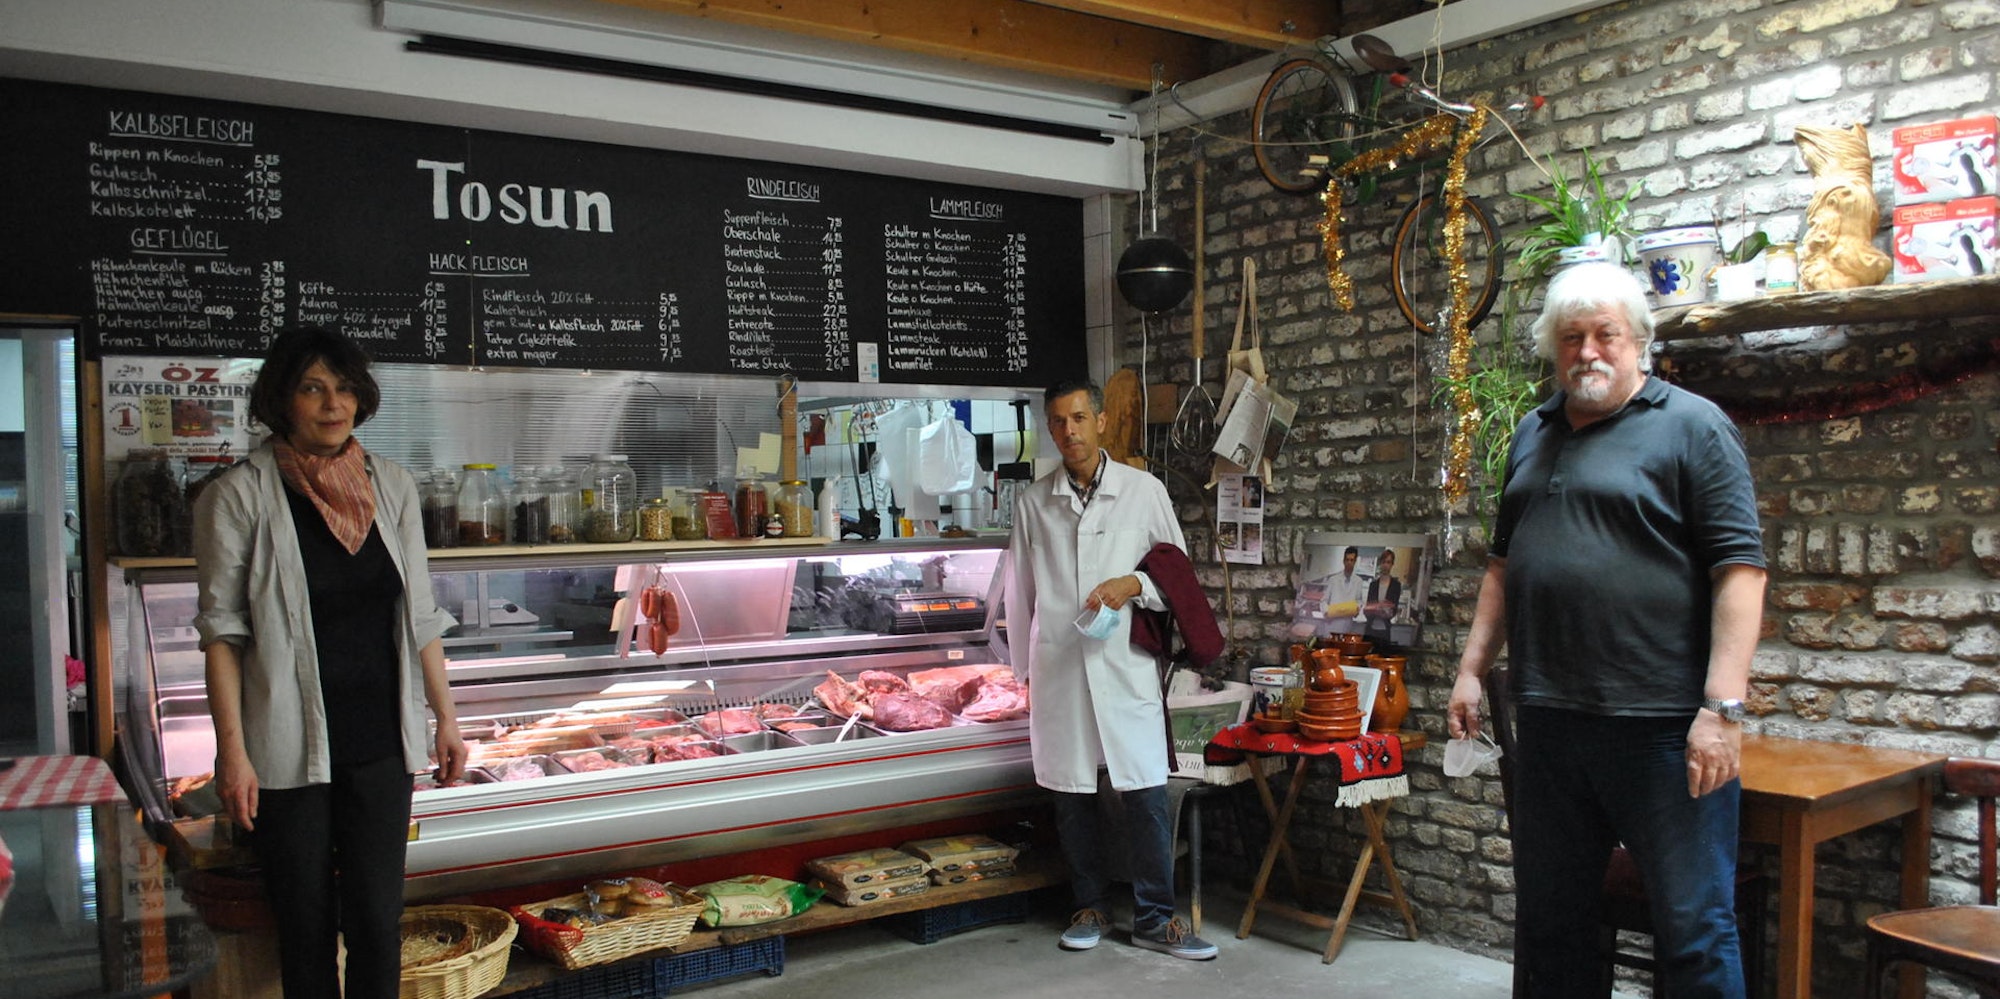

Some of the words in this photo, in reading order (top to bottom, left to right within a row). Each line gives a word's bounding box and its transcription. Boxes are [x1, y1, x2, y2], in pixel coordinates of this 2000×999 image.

[110, 111, 253, 141] KALBSFLEISCH
[89, 142, 140, 161] Rippen
[165, 149, 224, 167] Knochen
[90, 163, 157, 181] Gulasch
[91, 181, 206, 200] Kalbsschnitzel
[747, 177, 820, 199] RINDFLEISCH
[416, 159, 613, 233] Tosun
[92, 202, 196, 219] Kalbskotelett
[930, 197, 1003, 218] LAMMFLEISCH
[131, 225, 229, 249] GEFLÜGEL
[724, 225, 781, 243] Oberschale
[884, 224, 919, 238] Schulter
[933, 227, 971, 242] Knochen
[724, 244, 784, 260] Bratenstück
[885, 240, 920, 250] Schulter
[934, 241, 970, 252] Knochen
[91, 258, 185, 272] Hähnchenkeule
[430, 253, 467, 270] HACK
[472, 256, 528, 271] FLEISCH
[885, 252, 923, 263] Schulter
[726, 260, 765, 275] Roulade
[886, 264, 909, 276] Keule
[923, 265, 958, 278] Knochen
[93, 273, 189, 287] Hähnchenfilet
[725, 277, 767, 290] Gulasch
[887, 280, 909, 291] Keule
[96, 285, 165, 298] Hähnchen
[300, 281, 334, 295] Köfte
[727, 289, 755, 302] Rippe
[770, 291, 806, 302] Knochen
[300, 298, 338, 310] Adana
[483, 289, 546, 304] Rindfleisch
[887, 292, 909, 303] Keule
[97, 300, 199, 313] Hähnchenkeule
[99, 314, 211, 330] Putenschnitzel
[299, 310, 338, 326] Burger
[728, 319, 775, 331] Entrecote
[99, 333, 145, 347] Franz
[156, 333, 245, 349] Maishühner
[341, 327, 397, 340] Frikadelle
[888, 331, 941, 344] Lammsteak
[486, 348, 518, 359] extra
[523, 350, 558, 365] mager
[762, 358, 792, 370] Steak
[161, 363, 221, 383] ÖZ
